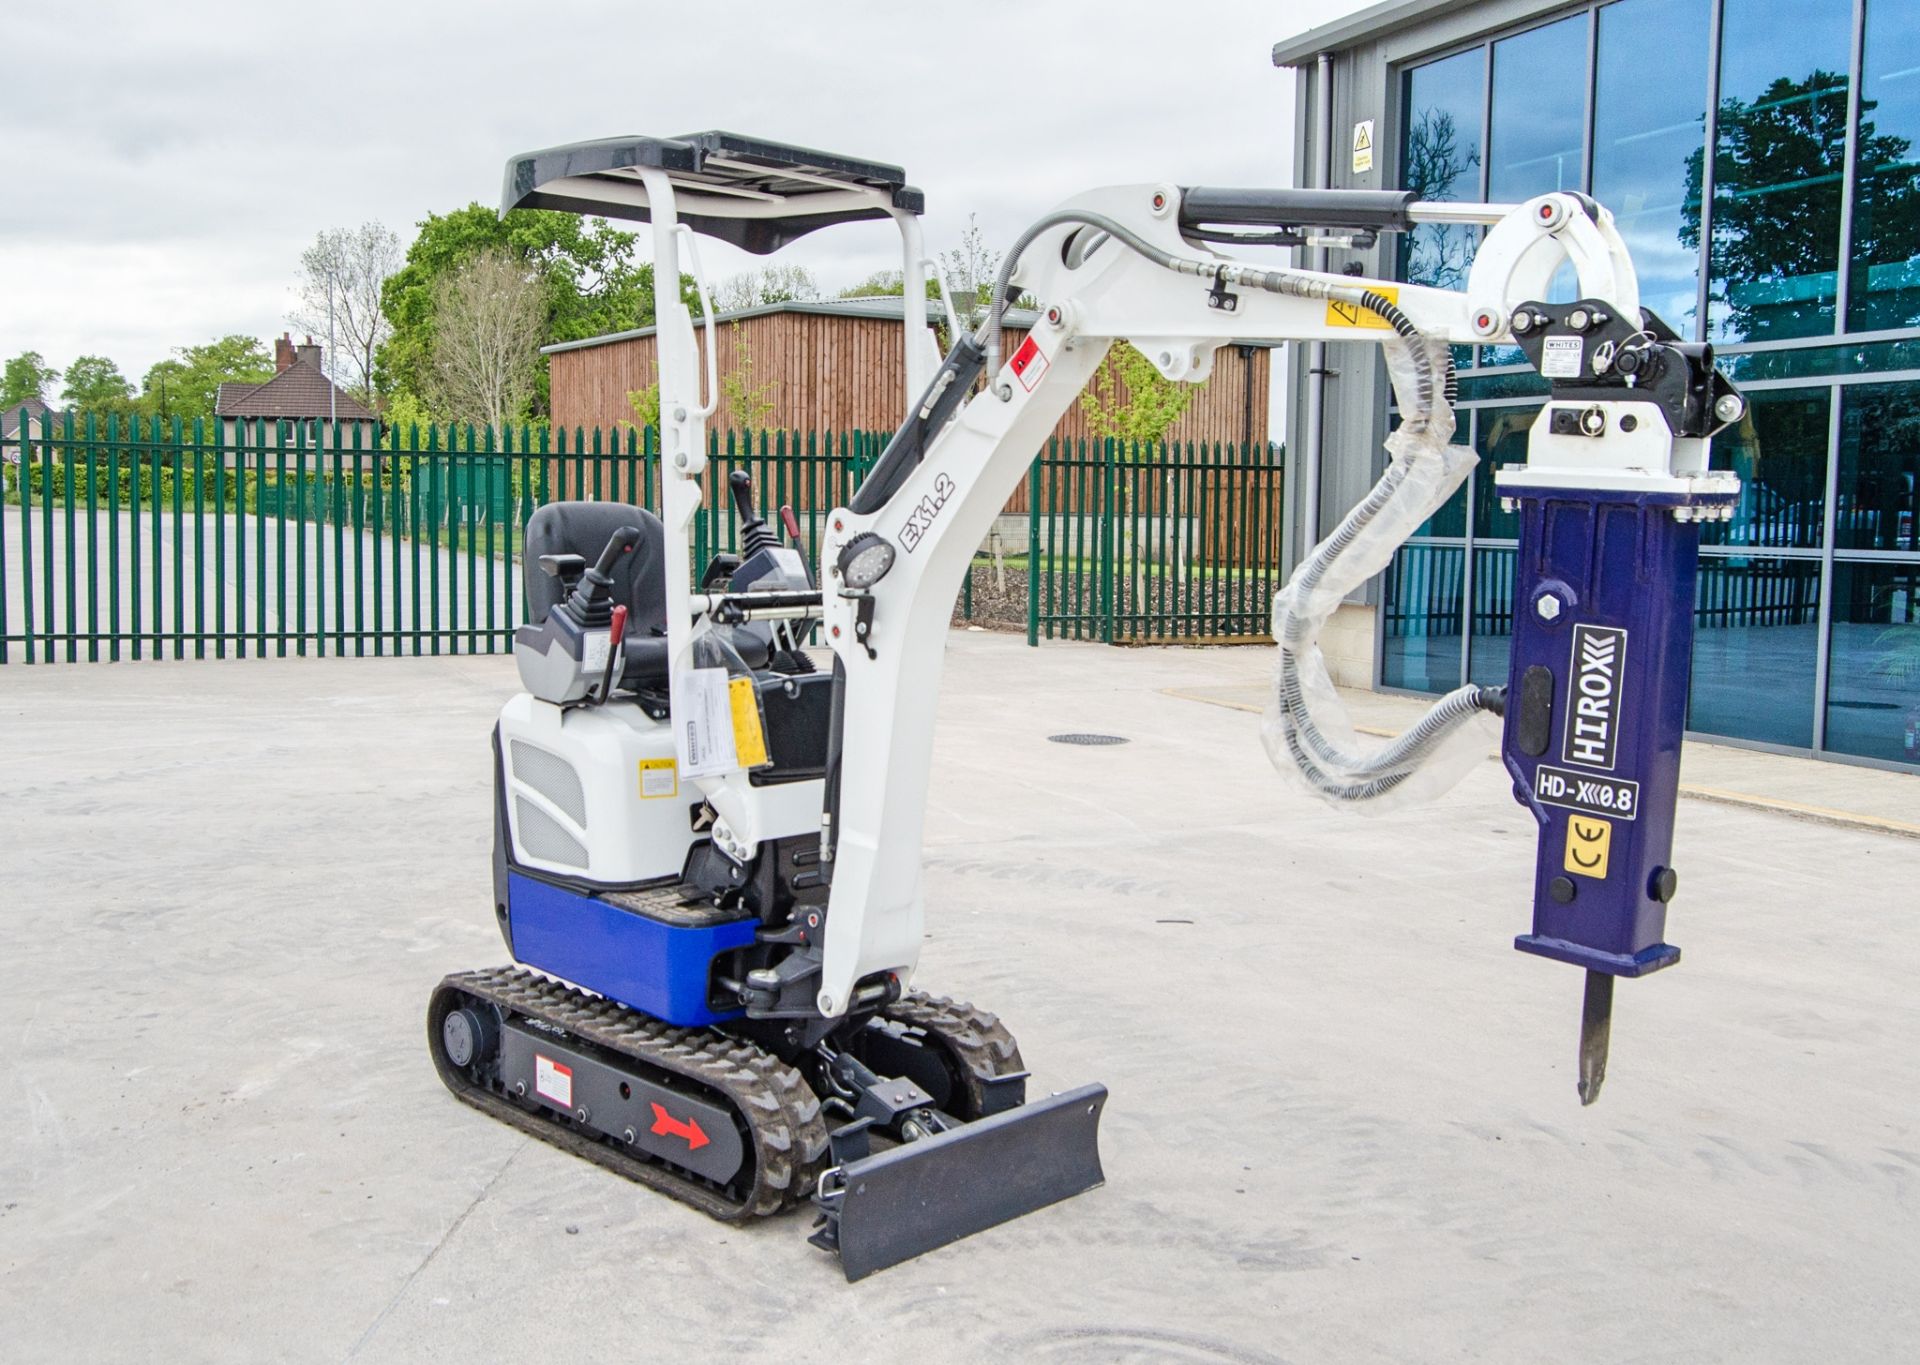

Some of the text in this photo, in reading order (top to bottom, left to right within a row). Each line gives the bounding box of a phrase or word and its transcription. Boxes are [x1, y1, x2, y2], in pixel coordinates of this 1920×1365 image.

[898, 472, 956, 554] EX1.2
[1573, 651, 1615, 763] HIROX
[1572, 822, 1604, 867] CE
